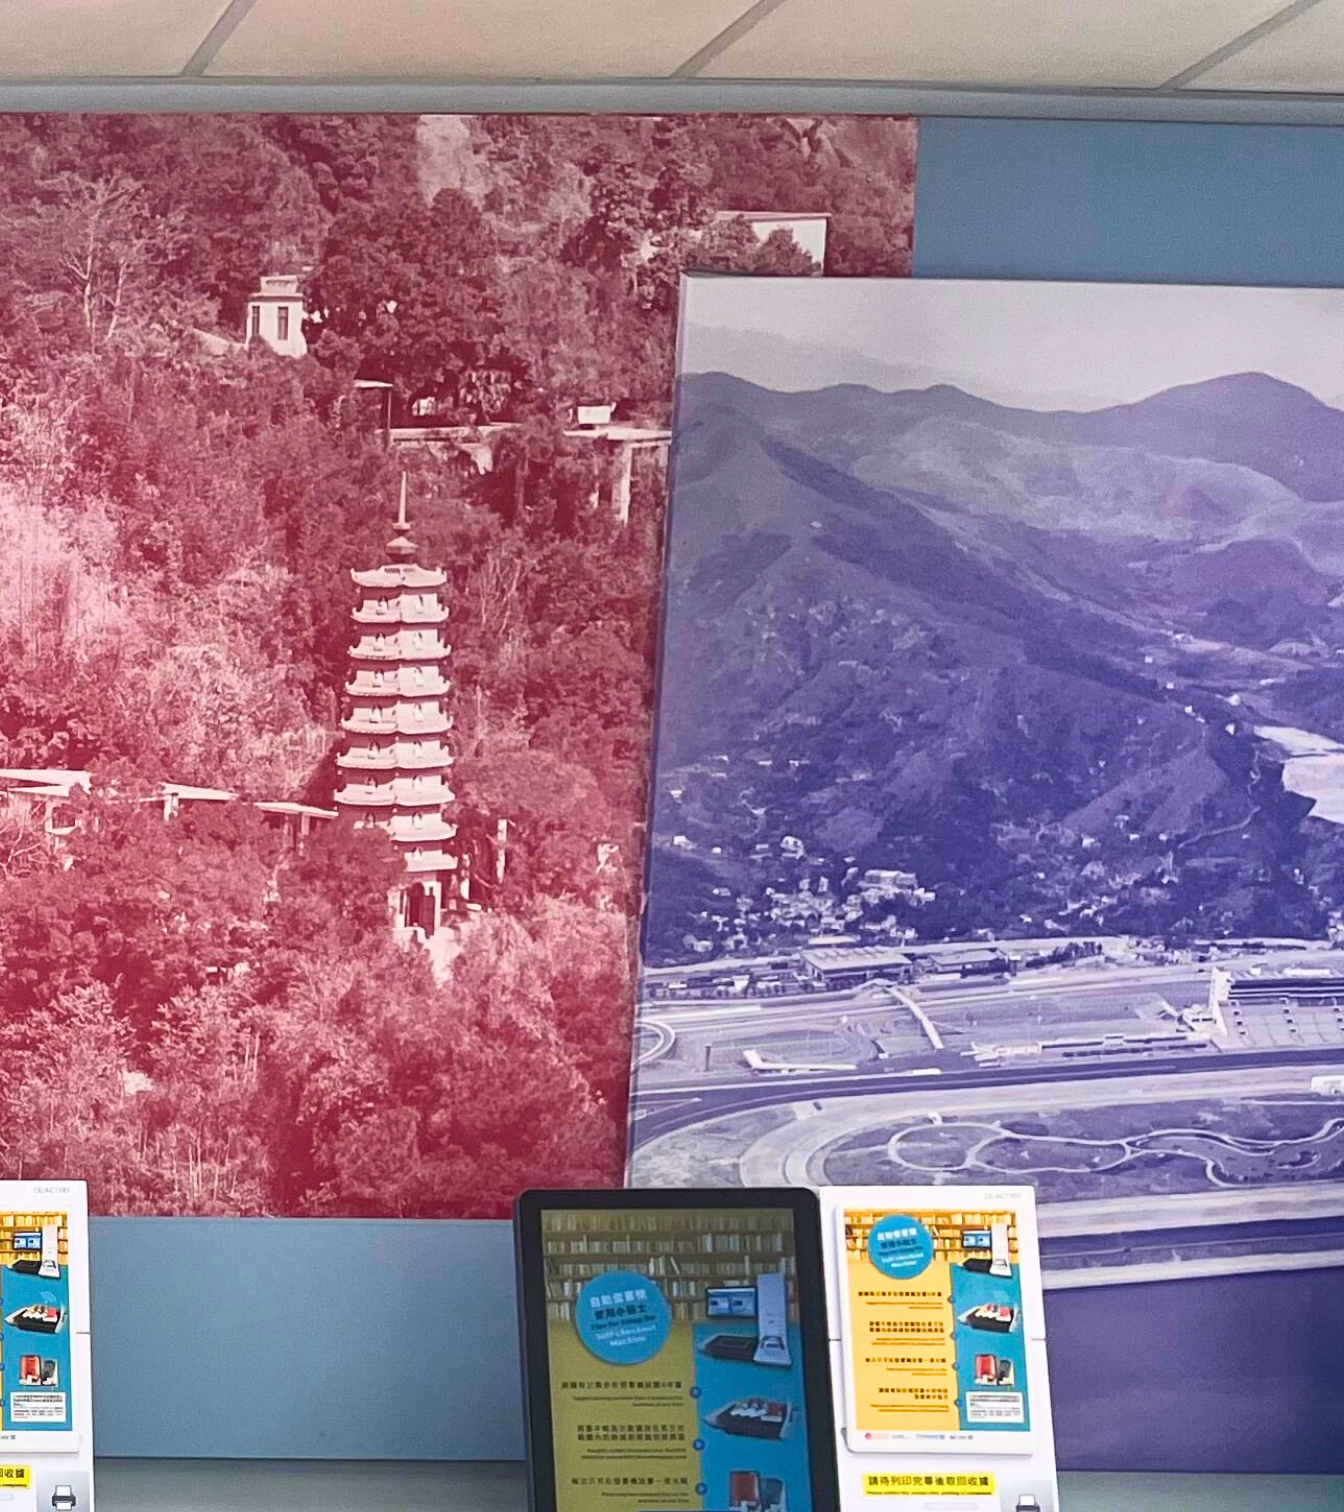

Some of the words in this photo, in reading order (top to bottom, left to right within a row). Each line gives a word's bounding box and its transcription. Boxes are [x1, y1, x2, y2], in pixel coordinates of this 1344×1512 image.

[869, 1476, 989, 1487] 請待列印完畢後取回收據
